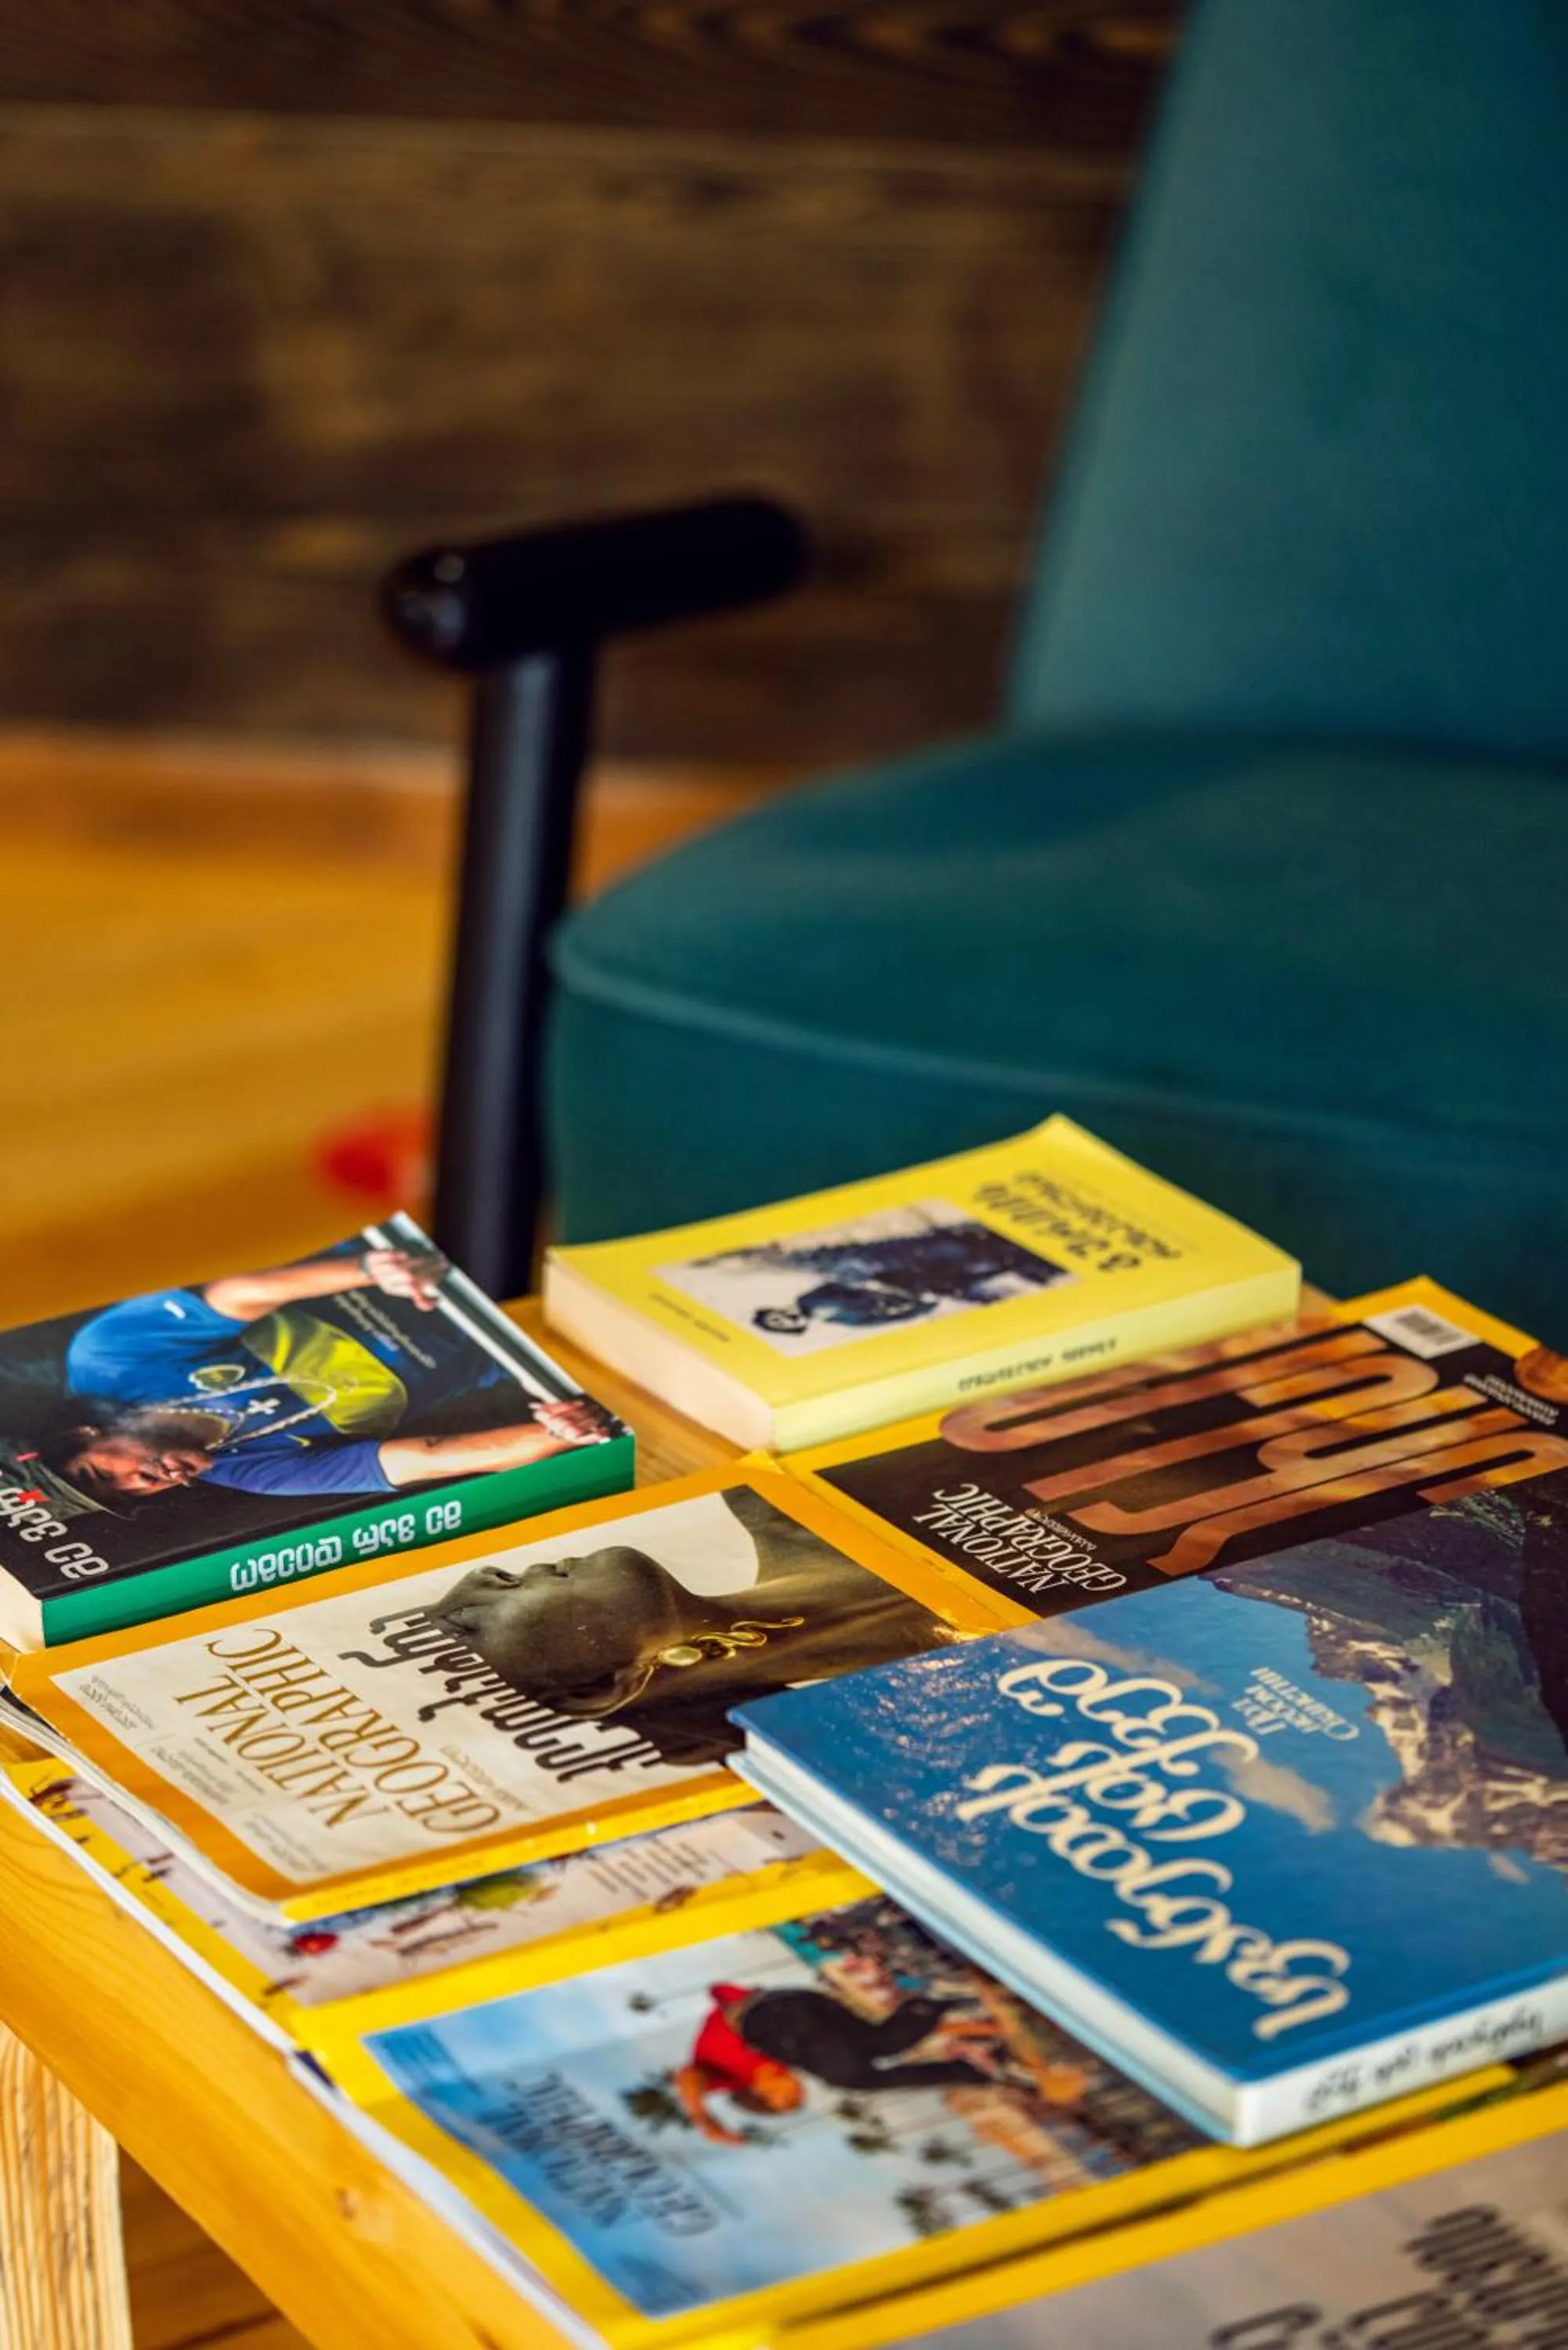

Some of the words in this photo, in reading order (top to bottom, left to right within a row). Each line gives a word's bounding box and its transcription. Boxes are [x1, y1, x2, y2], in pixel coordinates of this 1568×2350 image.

[352, 1513, 416, 1555] ვარ
[425, 1500, 462, 1535] მე
[912, 1503, 1070, 1594] NATIONAL
[932, 1483, 1128, 1591] GEOGRAPHIC
[44, 1542, 110, 1578] მე
[230, 1535, 342, 1592] დიეგო
[173, 1674, 391, 1829] NATIONAL
[205, 1628, 501, 1833] GEOGRAPHIC
